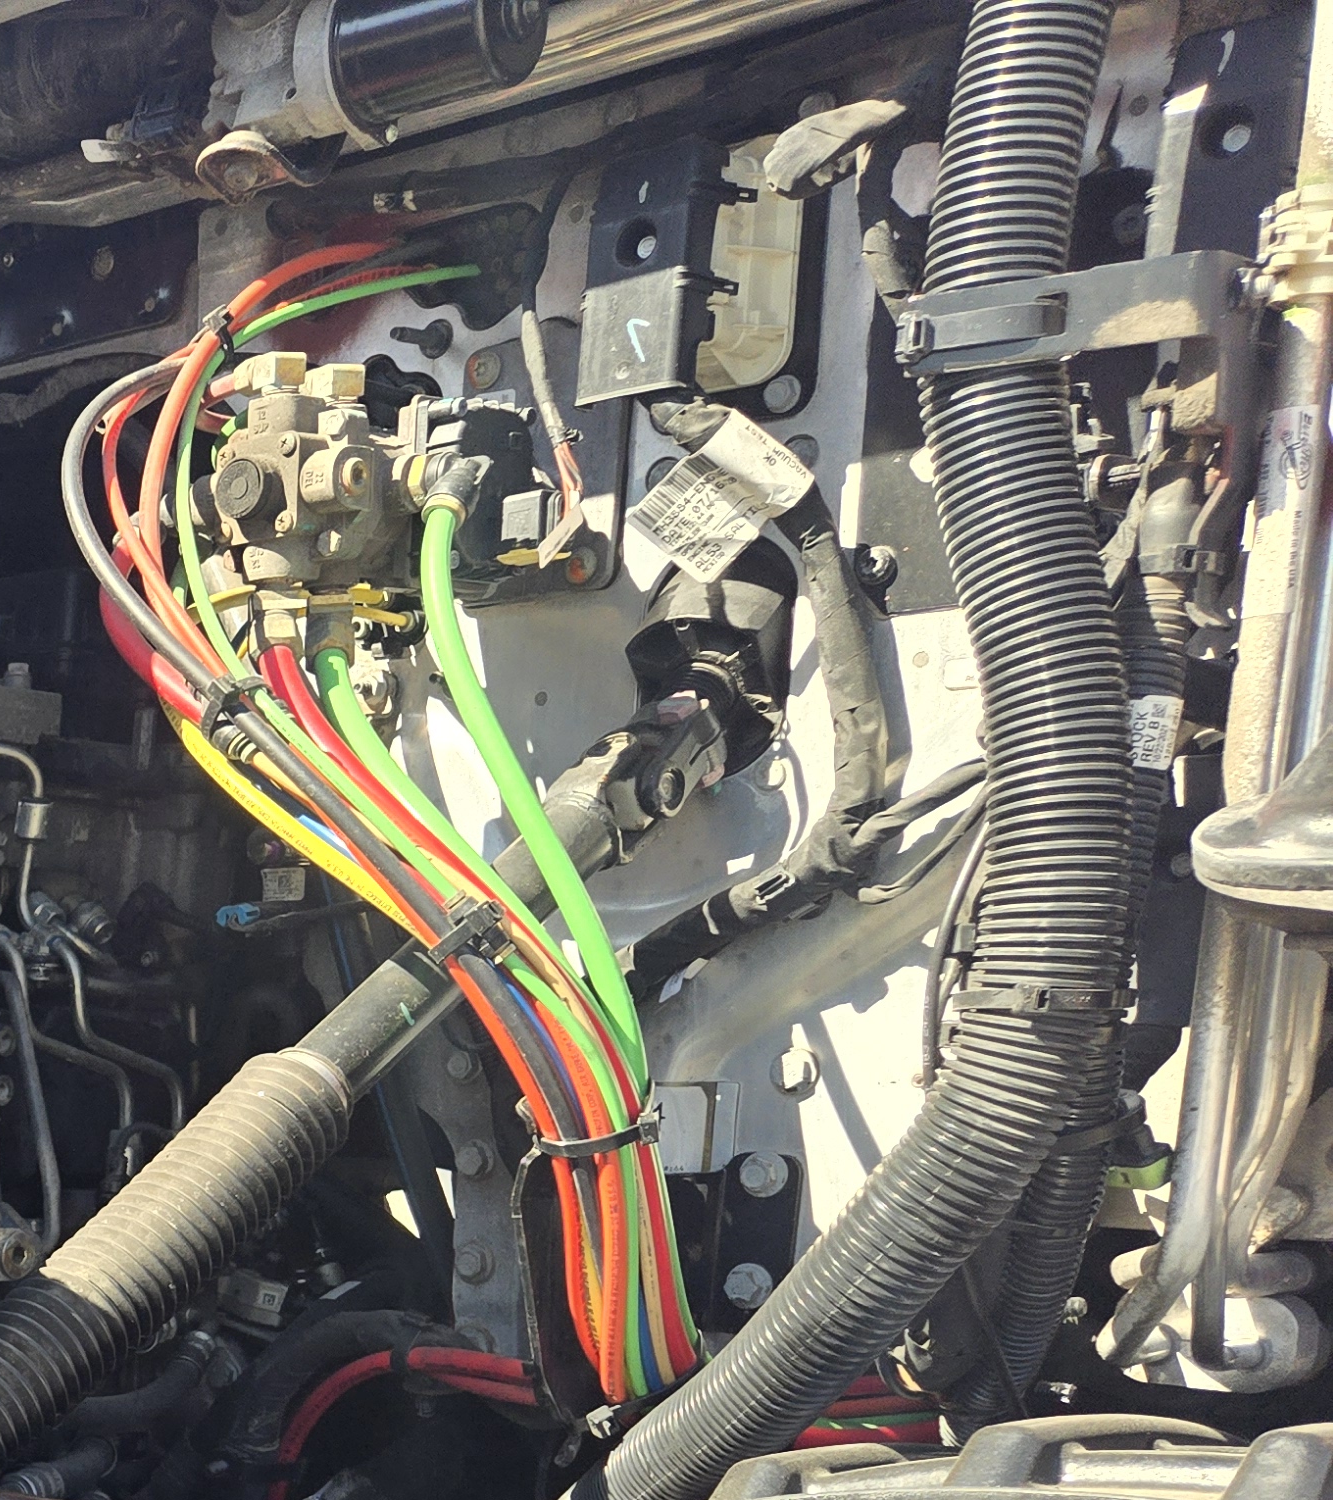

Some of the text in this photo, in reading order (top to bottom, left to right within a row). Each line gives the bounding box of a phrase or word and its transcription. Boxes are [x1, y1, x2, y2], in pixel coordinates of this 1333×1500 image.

[763, 451, 776, 467] OK
[696, 543, 722, 569] AL53
[1141, 720, 1159, 762] REV B
